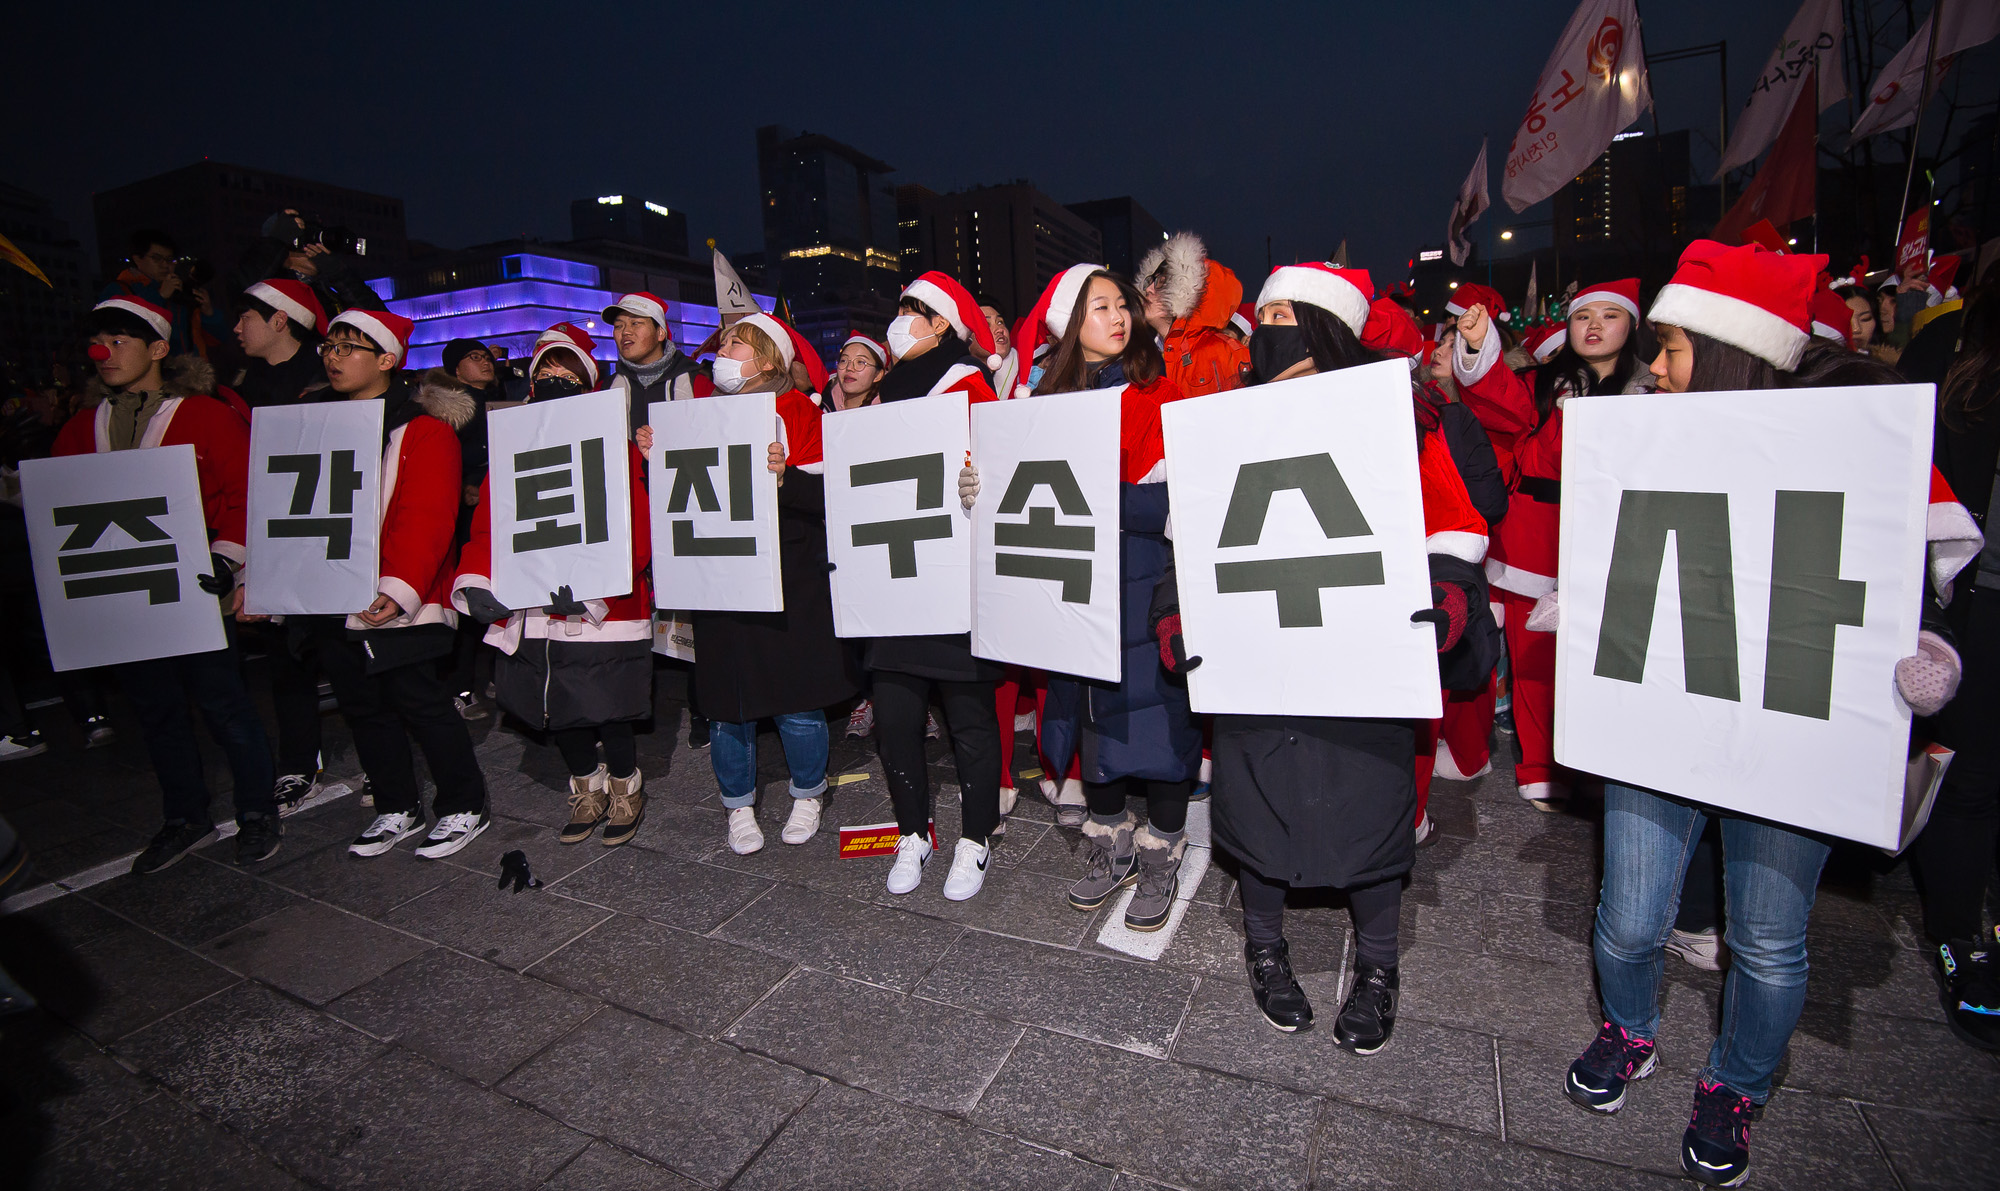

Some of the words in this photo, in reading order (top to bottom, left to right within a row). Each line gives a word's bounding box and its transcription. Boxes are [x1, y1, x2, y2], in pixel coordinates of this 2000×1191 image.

[52, 496, 181, 605] 즉
[267, 449, 363, 560] 각
[512, 437, 609, 553] 퇴
[665, 444, 757, 556] 진
[850, 452, 953, 579] 구
[994, 460, 1096, 604] 속
[1215, 452, 1385, 628] 수
[1593, 489, 1866, 721] 사
